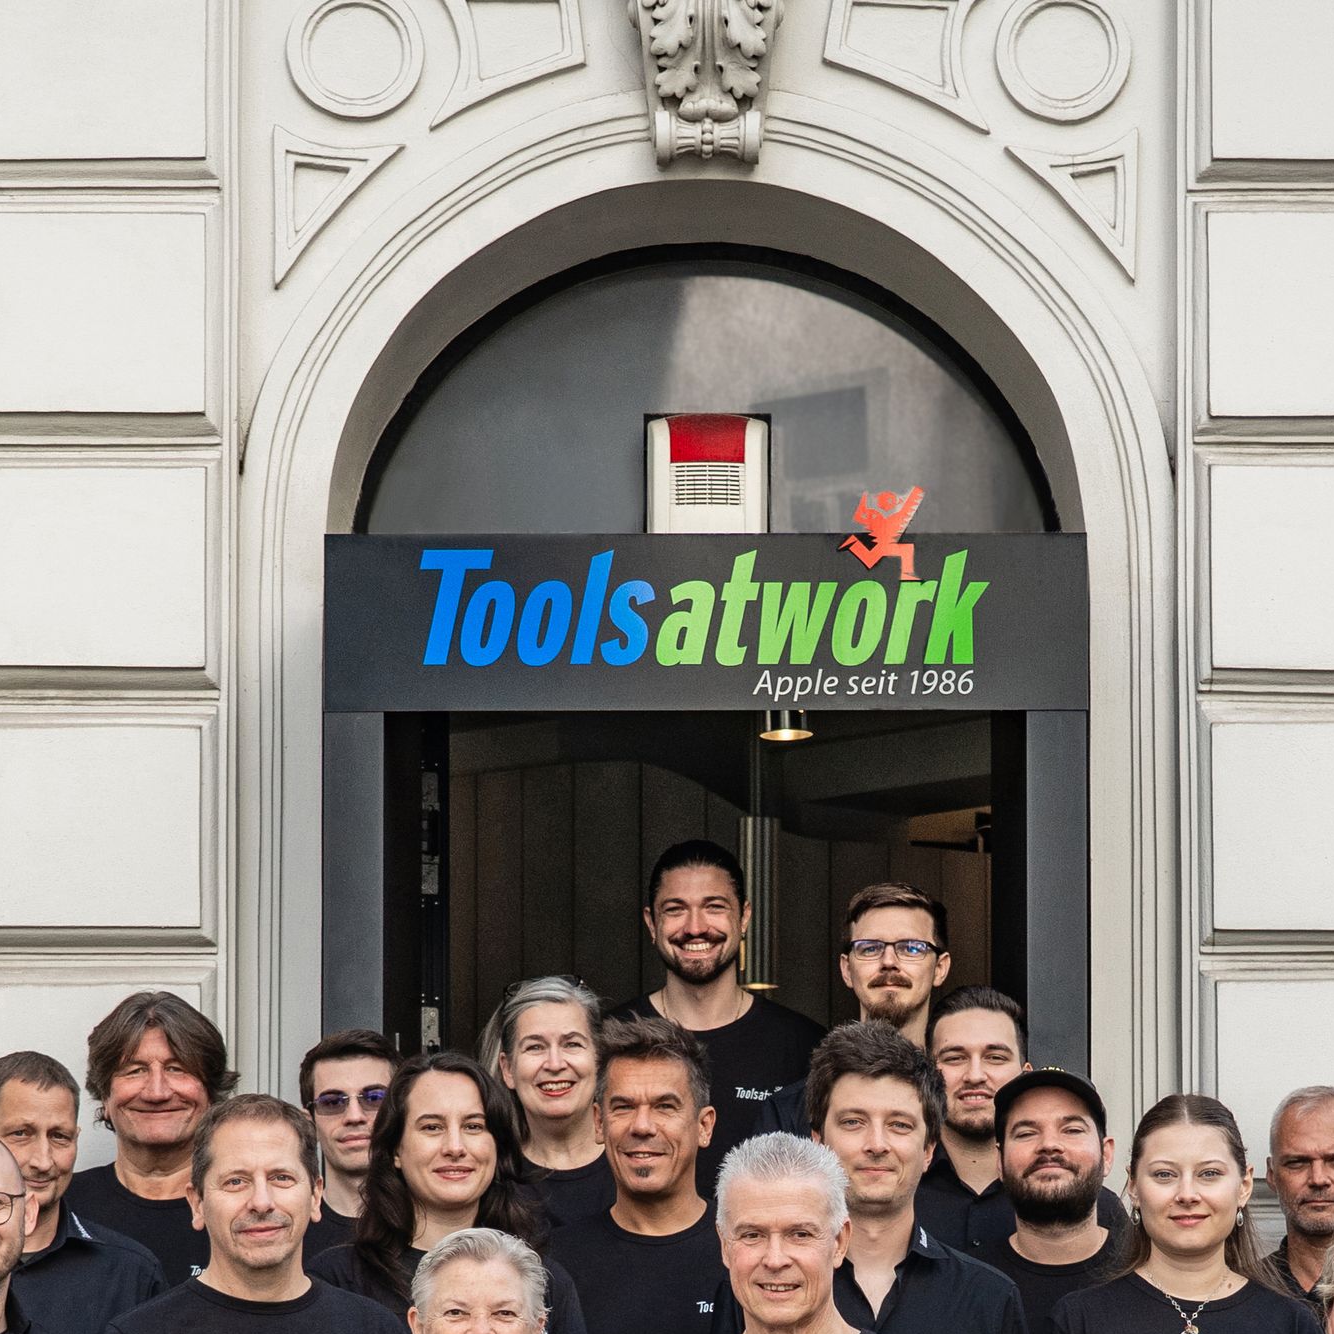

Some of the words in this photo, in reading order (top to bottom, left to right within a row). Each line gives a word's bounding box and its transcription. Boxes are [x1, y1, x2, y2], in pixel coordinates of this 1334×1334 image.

[419, 548, 991, 667] Toolsatwork
[752, 668, 839, 702] Apple
[846, 669, 899, 695] seit
[910, 669, 975, 695] 1986
